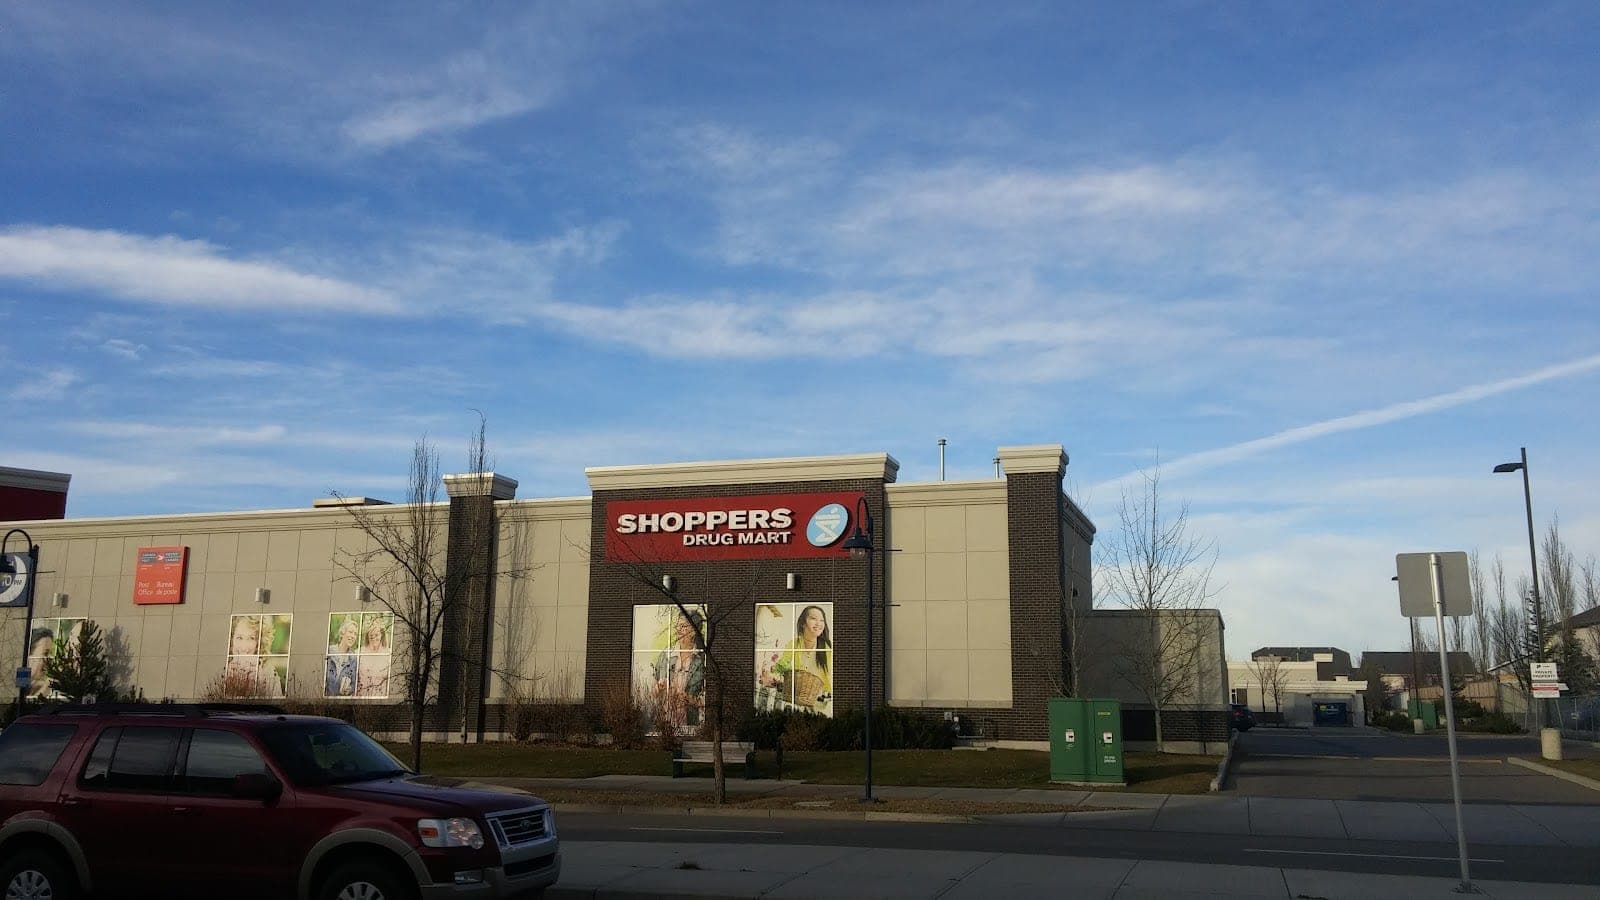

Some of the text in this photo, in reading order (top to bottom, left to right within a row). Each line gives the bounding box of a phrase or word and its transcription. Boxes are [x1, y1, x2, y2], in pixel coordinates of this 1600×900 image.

[616, 508, 792, 534] SHOPPERS
[683, 531, 792, 546] DRUG MART
[137, 588, 153, 596] Office
